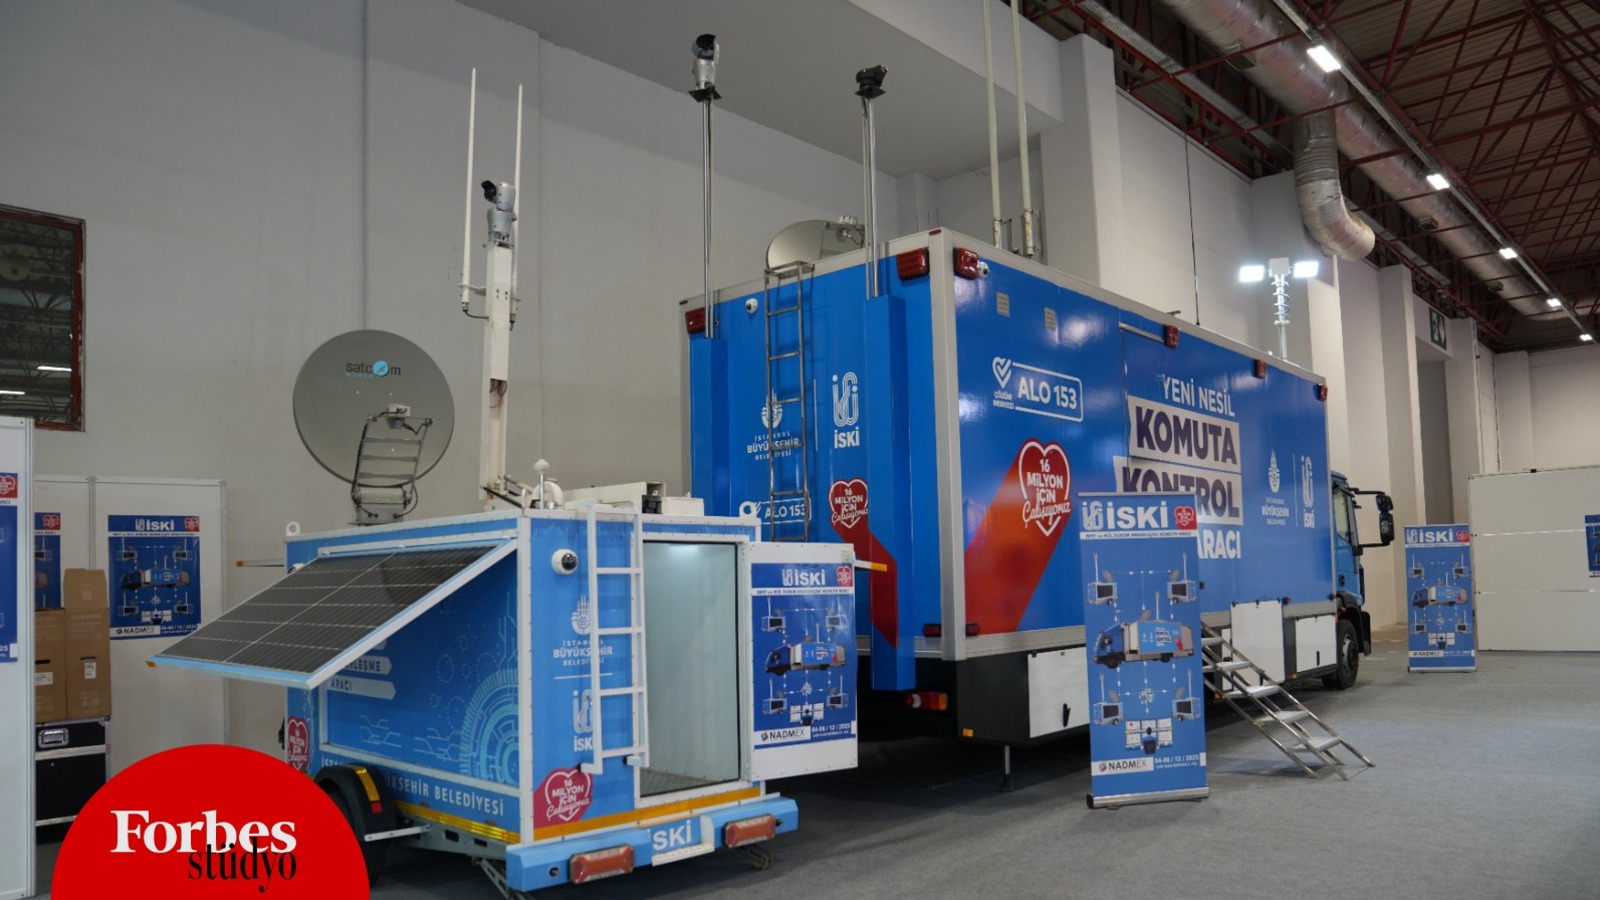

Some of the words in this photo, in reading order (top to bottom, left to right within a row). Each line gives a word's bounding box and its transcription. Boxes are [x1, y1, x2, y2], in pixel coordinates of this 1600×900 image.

[1018, 376, 1051, 404] ALO
[1053, 385, 1077, 410] 153
[1163, 376, 1195, 407] YENİ
[1198, 386, 1235, 417] NESİL
[833, 426, 860, 449] İSKİ
[1135, 405, 1237, 465] KOMUTA
[1039, 458, 1051, 473] 16
[1026, 471, 1064, 490] MİLYON
[1106, 500, 1169, 530] İSKİ
[146, 518, 175, 532] İSKİ
[1418, 528, 1454, 544] İSKİ
[795, 569, 825, 586] İSKİ
[769, 728, 805, 741] NADMEX
[573, 735, 594, 753] İSK
[1108, 758, 1147, 772] NADMEX
[434, 785, 505, 817] BELEDİYESİ
